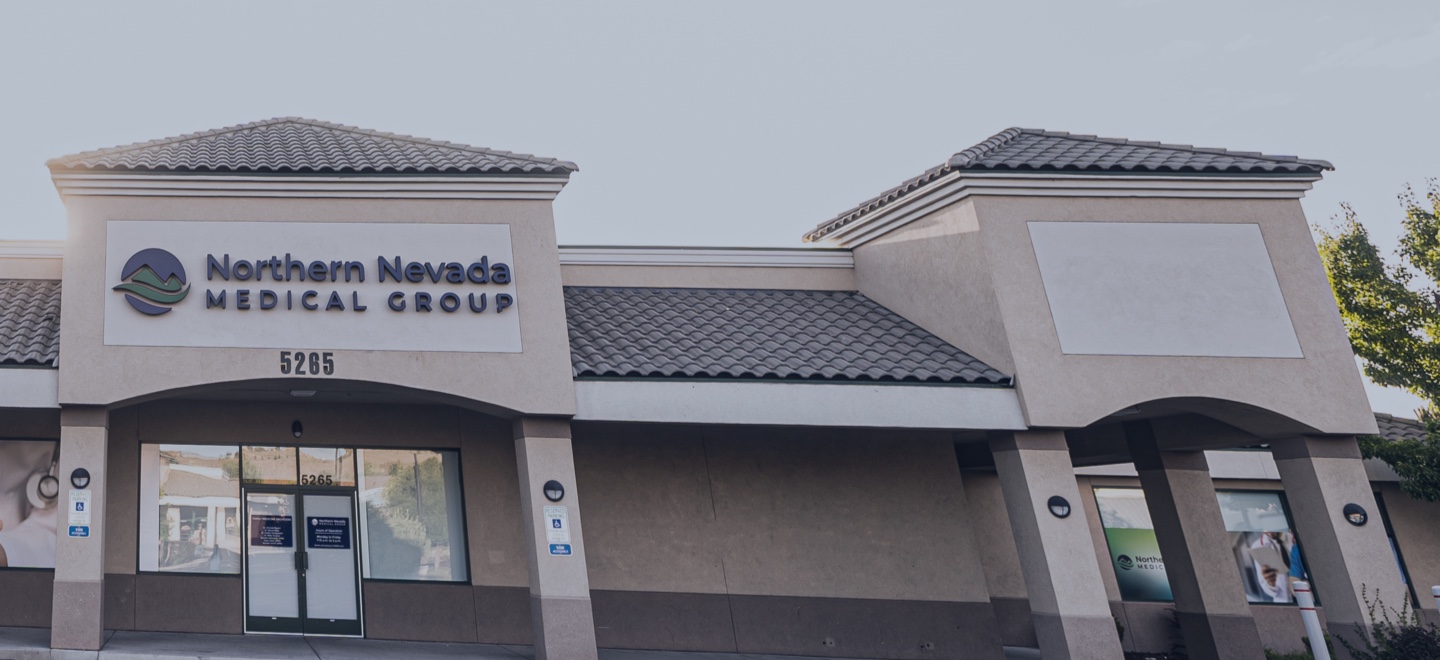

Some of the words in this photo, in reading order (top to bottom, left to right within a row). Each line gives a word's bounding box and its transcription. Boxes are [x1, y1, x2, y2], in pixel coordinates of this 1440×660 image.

[207, 253, 366, 282] Northern
[377, 256, 511, 284] Nevada
[206, 289, 367, 311] MEDICAL
[388, 291, 513, 313] GROUP
[280, 351, 334, 375] 5265
[301, 475, 333, 486] 5265
